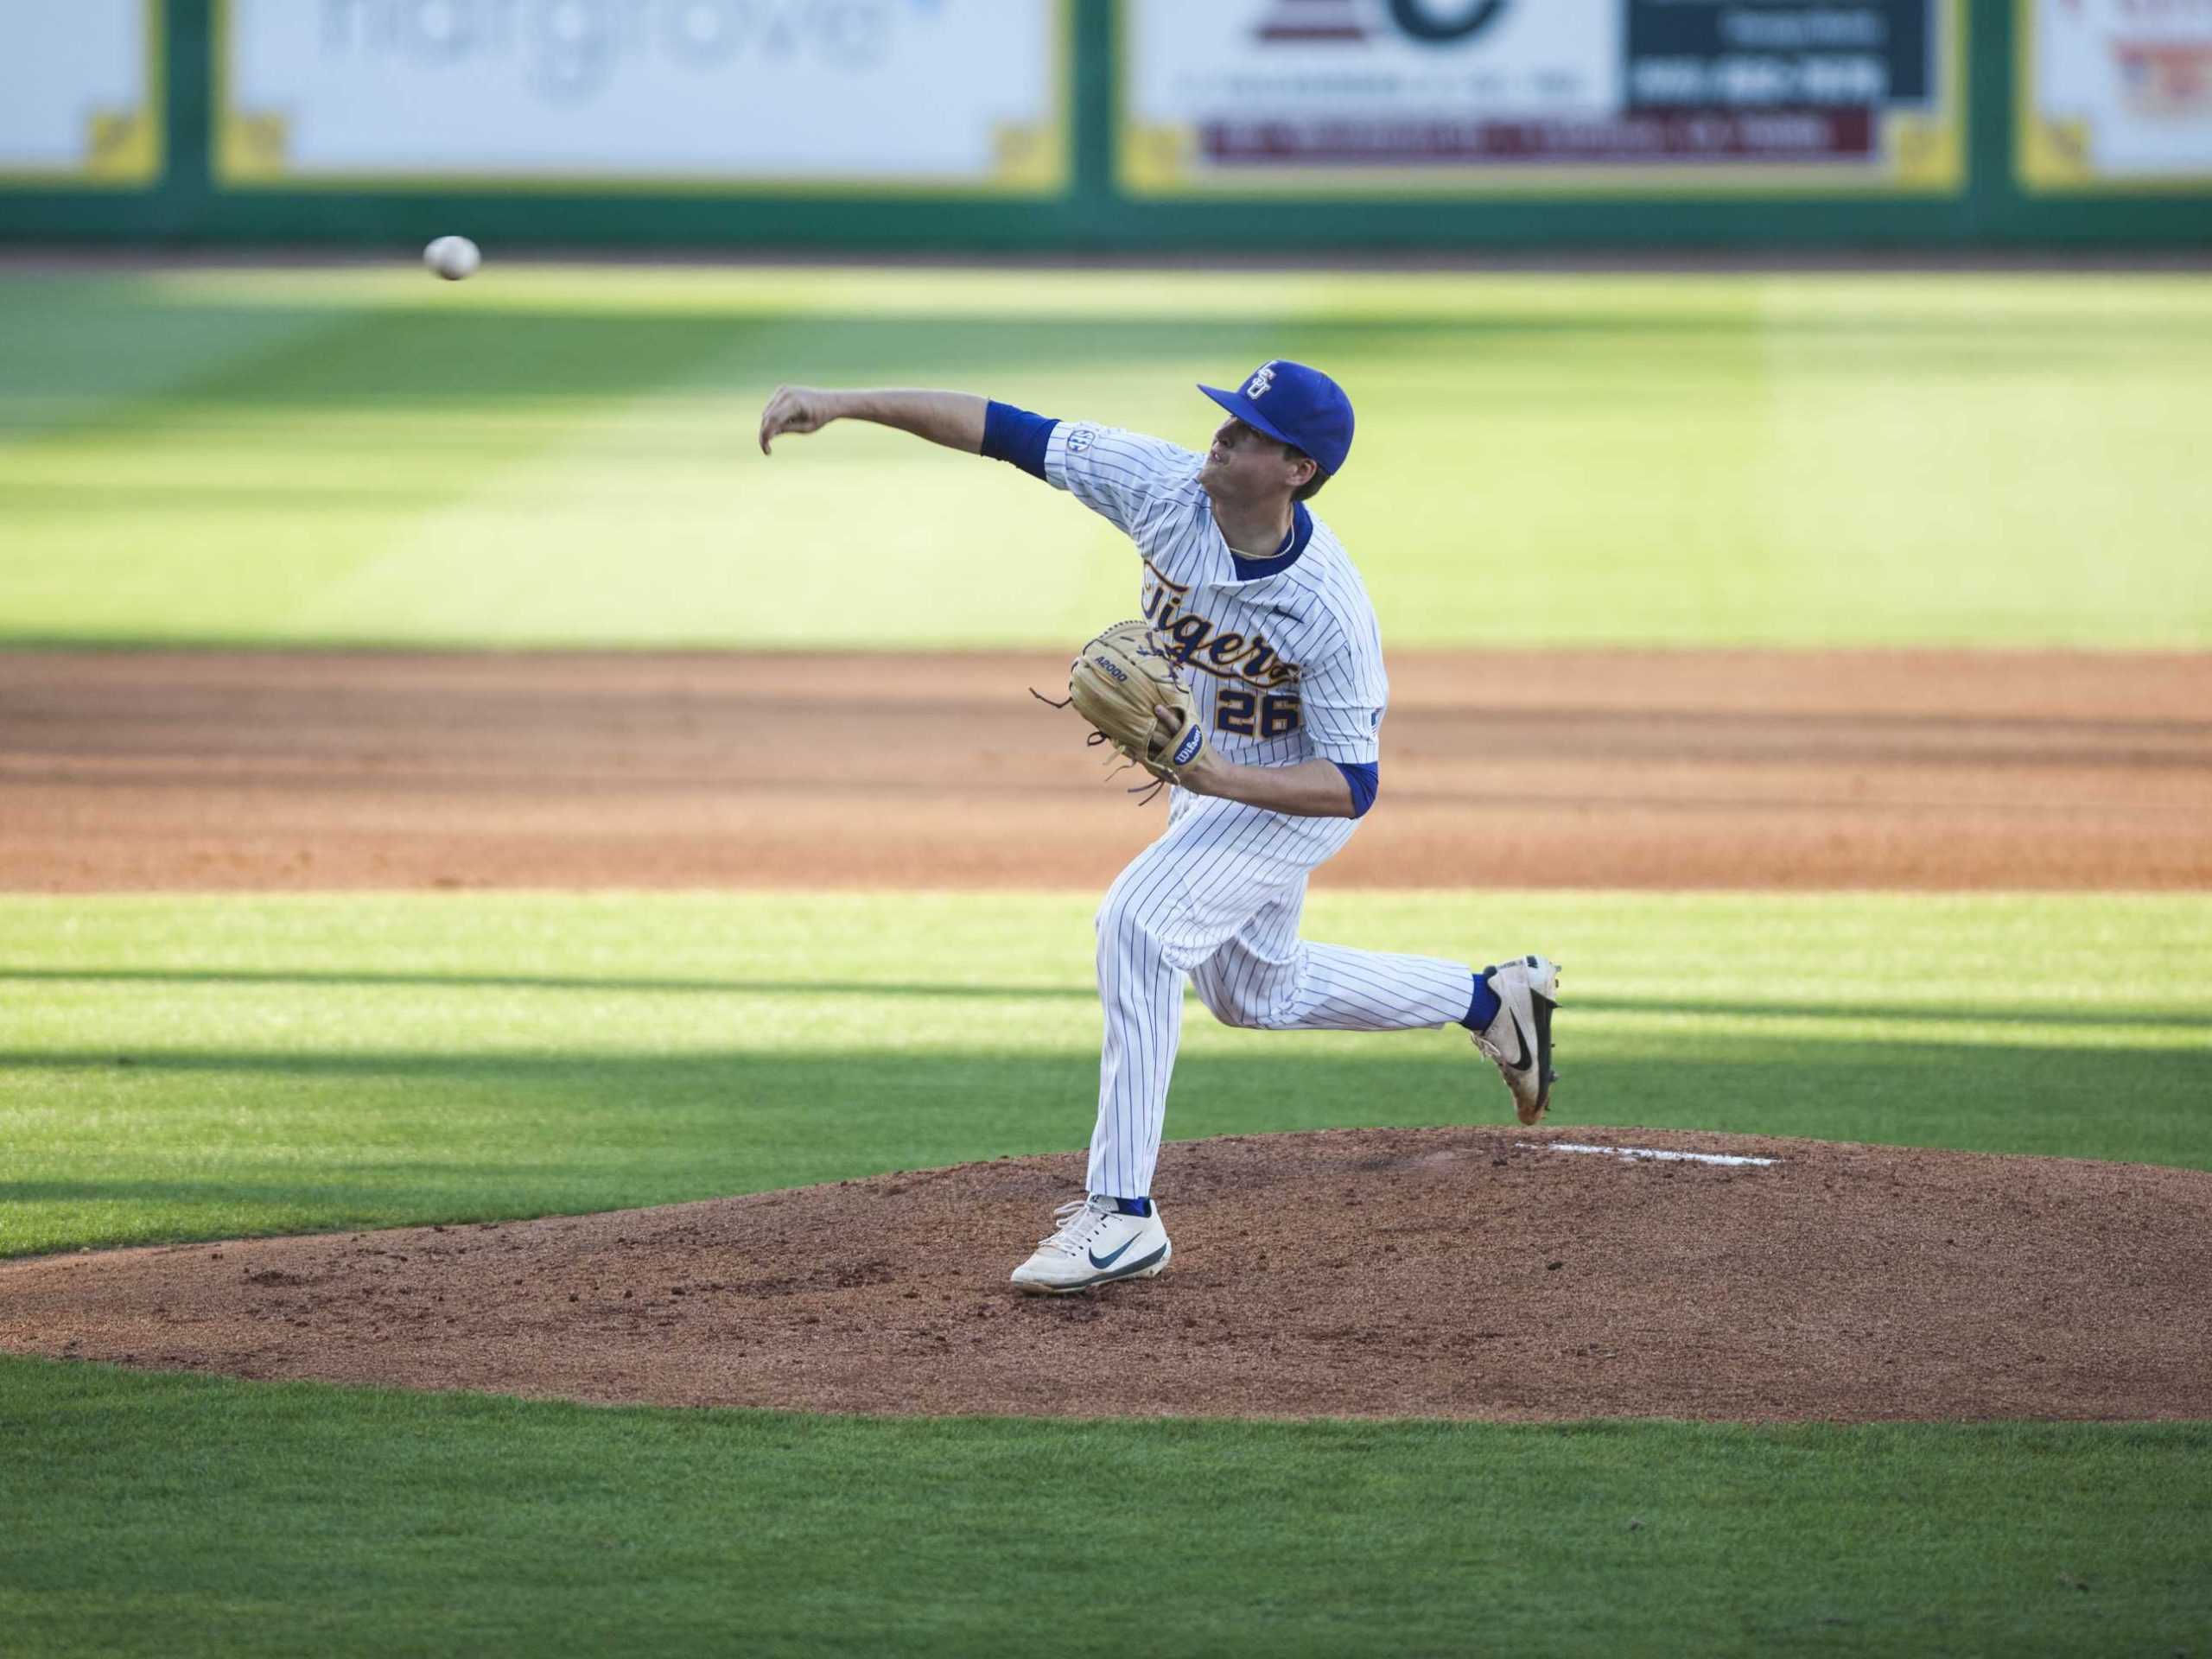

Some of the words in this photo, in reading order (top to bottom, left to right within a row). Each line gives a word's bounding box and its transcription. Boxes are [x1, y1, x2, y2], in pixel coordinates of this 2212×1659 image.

[1141, 558, 1303, 689] Tigers
[1094, 656, 1128, 682] A2000
[1215, 689, 1303, 739] 26
[1176, 728, 1202, 763] Wilson
